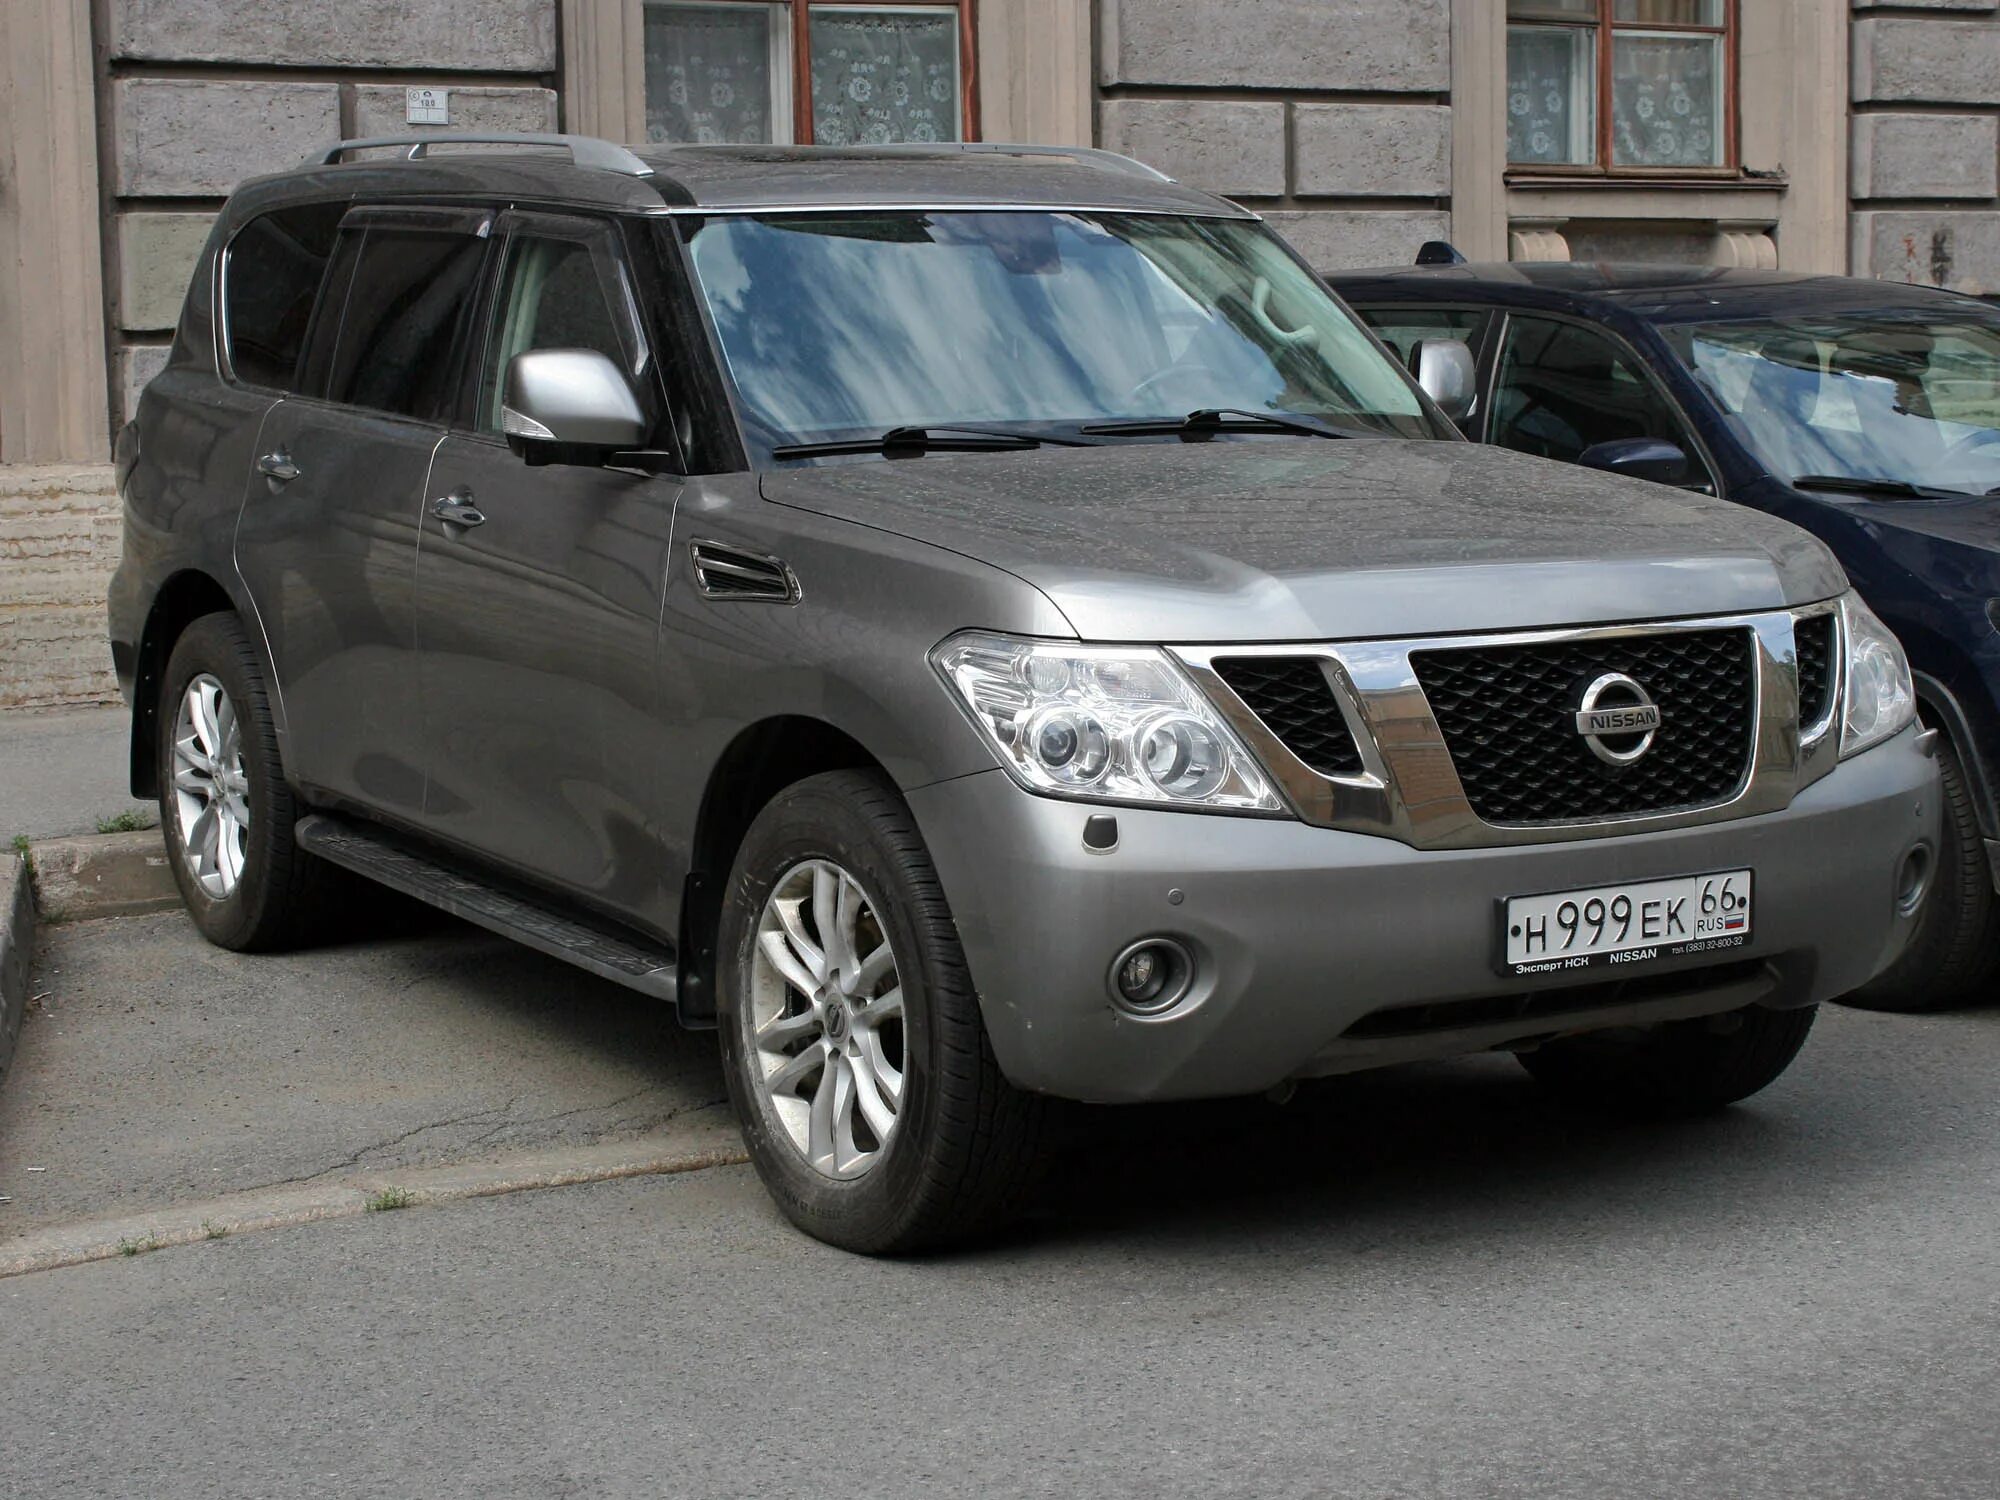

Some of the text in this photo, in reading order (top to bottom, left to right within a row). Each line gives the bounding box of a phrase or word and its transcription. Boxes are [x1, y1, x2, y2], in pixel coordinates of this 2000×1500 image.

[1590, 709, 1656, 729] NISSAN
[1700, 877, 1736, 915] 66
[1697, 917, 1724, 933] RUS
[1685, 941, 1706, 953] (383)
[1706, 936, 1743, 950] 32-800-32
[1610, 948, 1657, 964] NISSAN
[1515, 957, 1589, 975] Эксперт НСК
